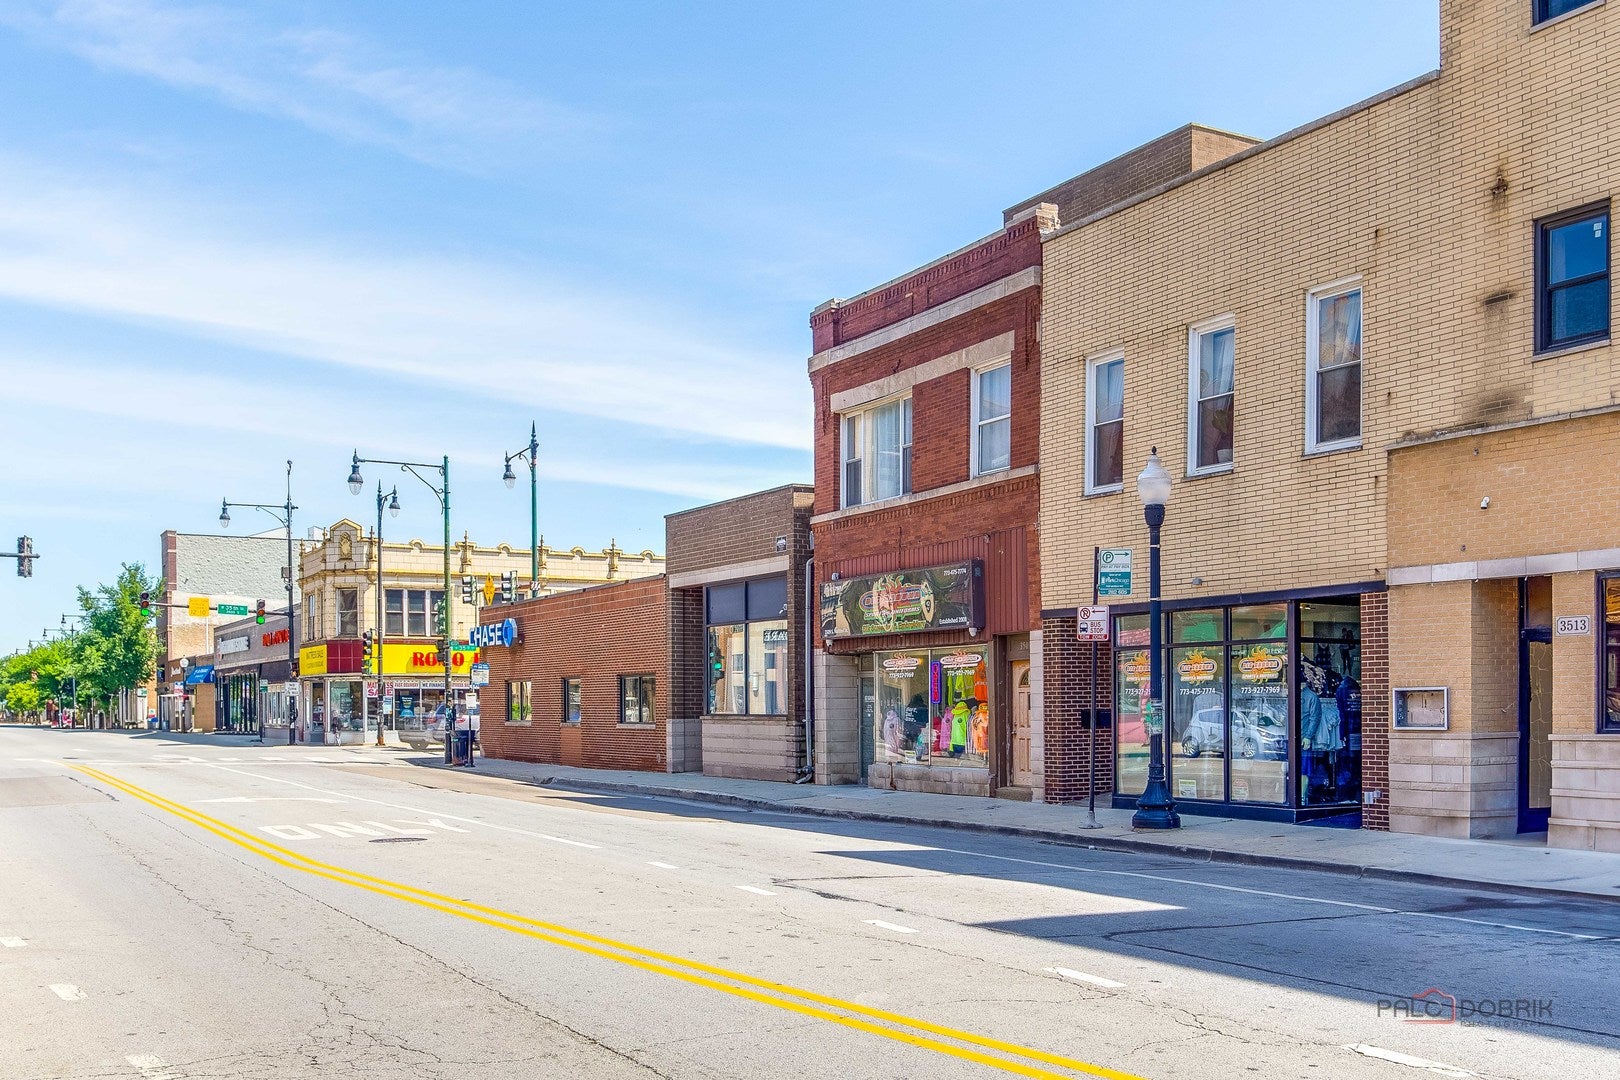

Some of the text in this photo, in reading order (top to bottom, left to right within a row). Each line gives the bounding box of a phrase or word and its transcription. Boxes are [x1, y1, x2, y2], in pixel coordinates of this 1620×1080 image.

[1560, 620, 1587, 631] 3513
[468, 622, 503, 647] CHASE
[412, 651, 465, 667] ROO
[367, 688, 393, 697] SAE
[1179, 687, 1216, 696] 773-475-7774
[1240, 686, 1280, 694] 773-927-7969
[256, 818, 473, 841] ONLY
